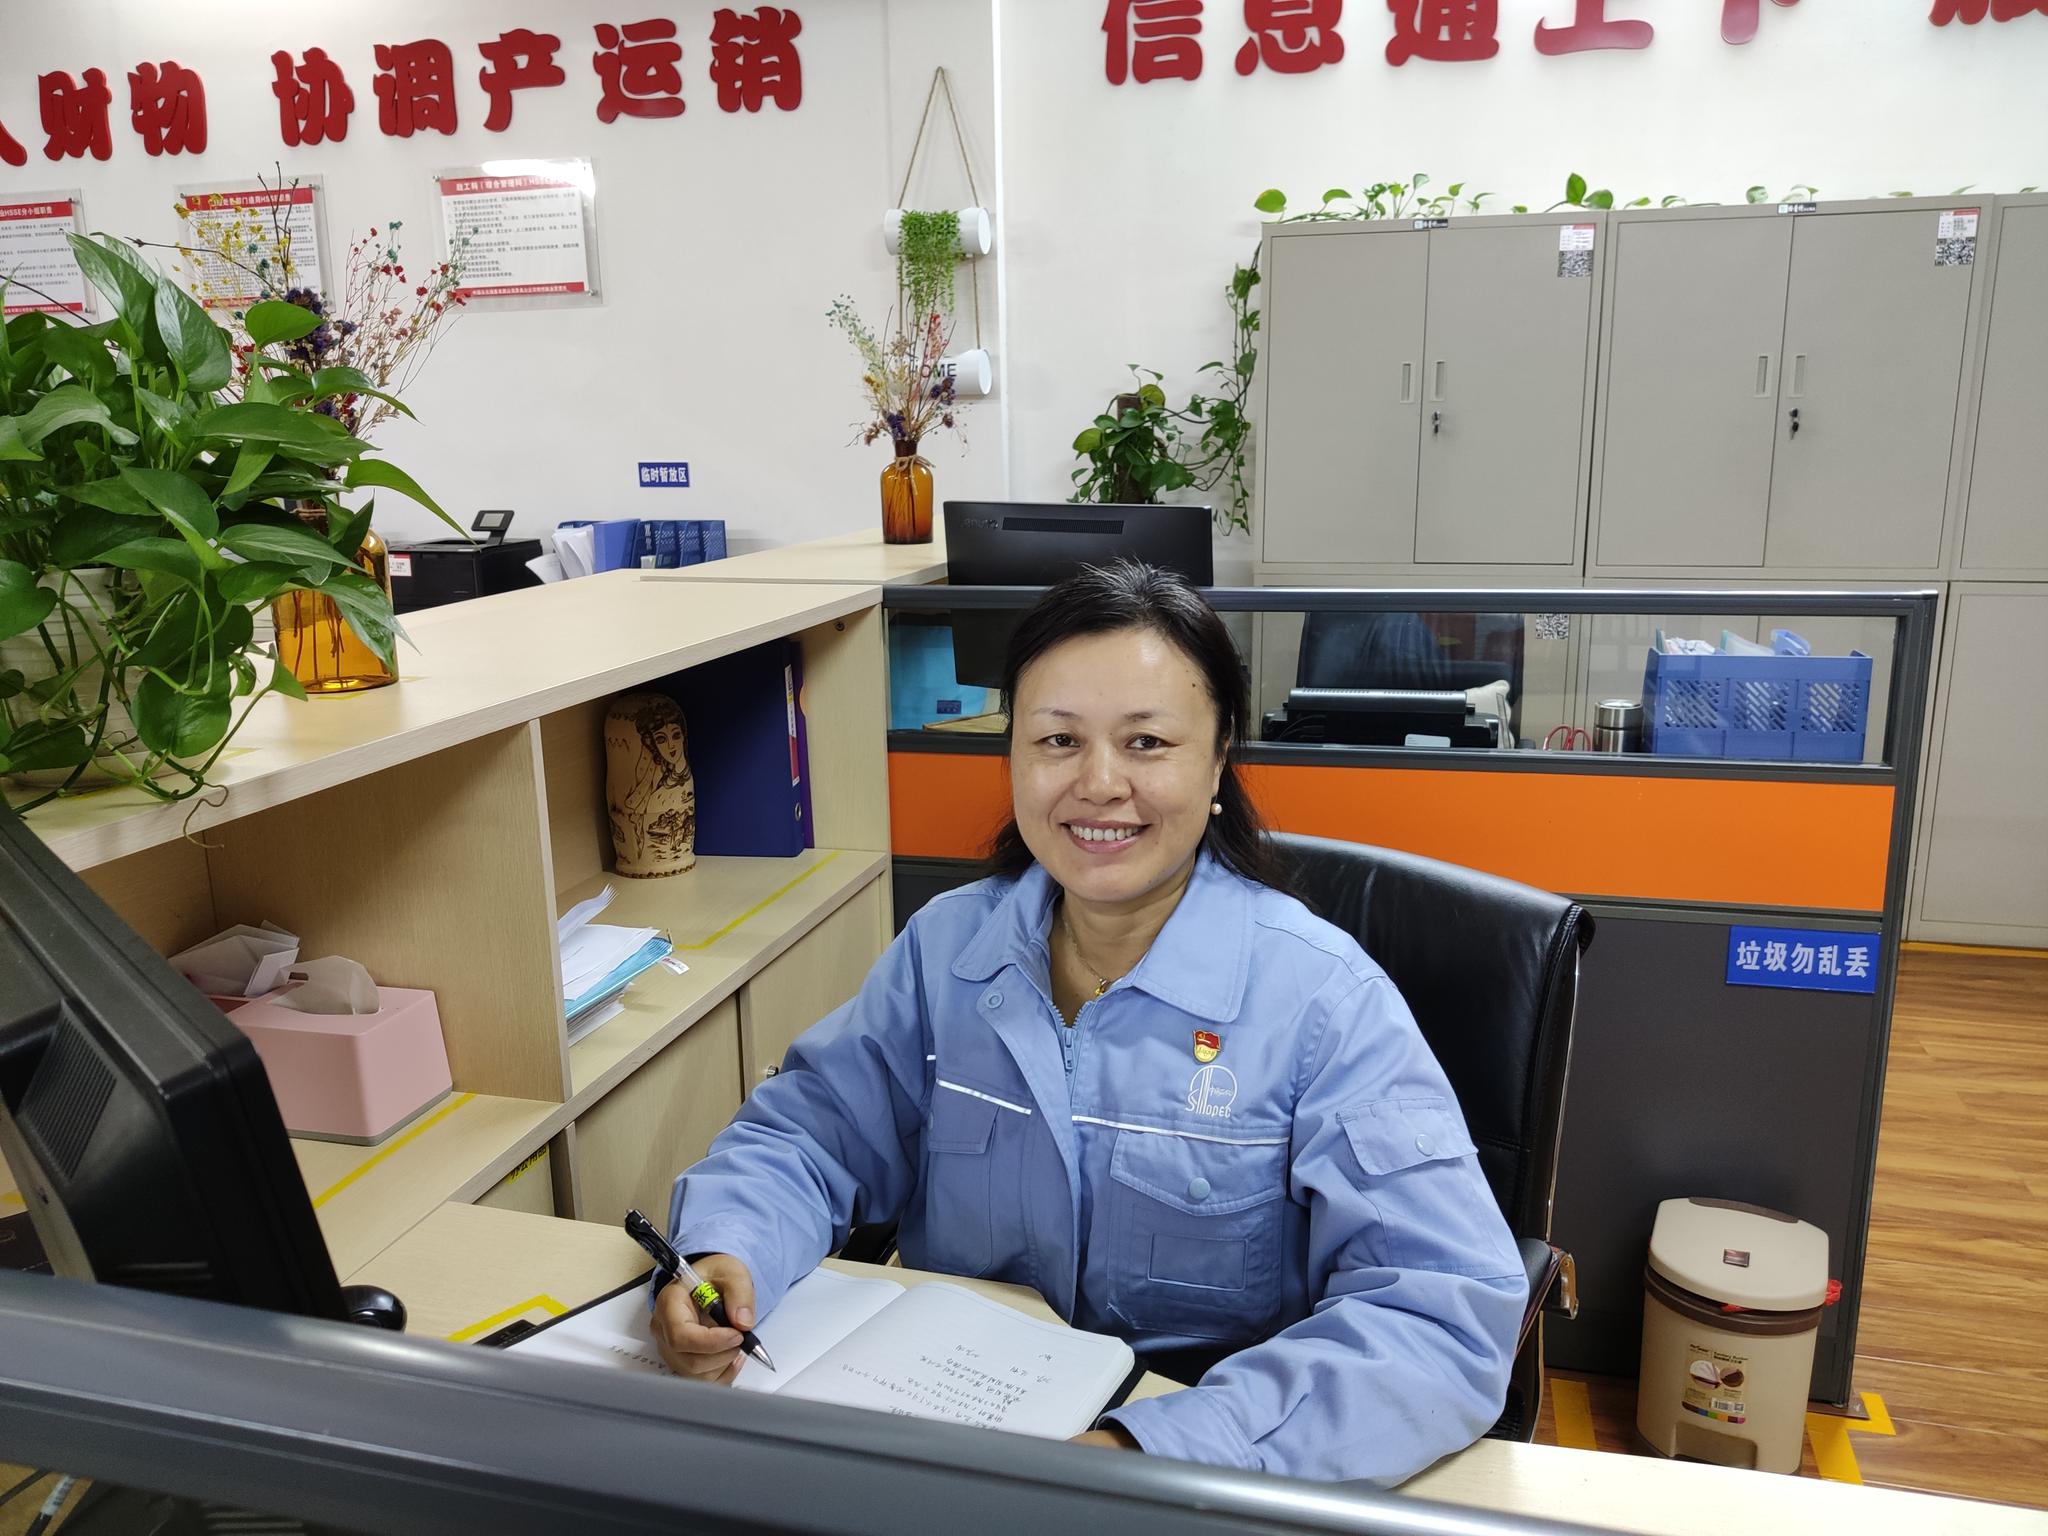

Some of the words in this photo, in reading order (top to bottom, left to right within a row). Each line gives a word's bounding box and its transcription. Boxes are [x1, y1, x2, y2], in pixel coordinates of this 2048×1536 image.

[271, 6, 802, 147] 协调产运销
[641, 466, 688, 483] 临时暂放区
[1735, 939, 1871, 979] 垃圾勿乱丢
